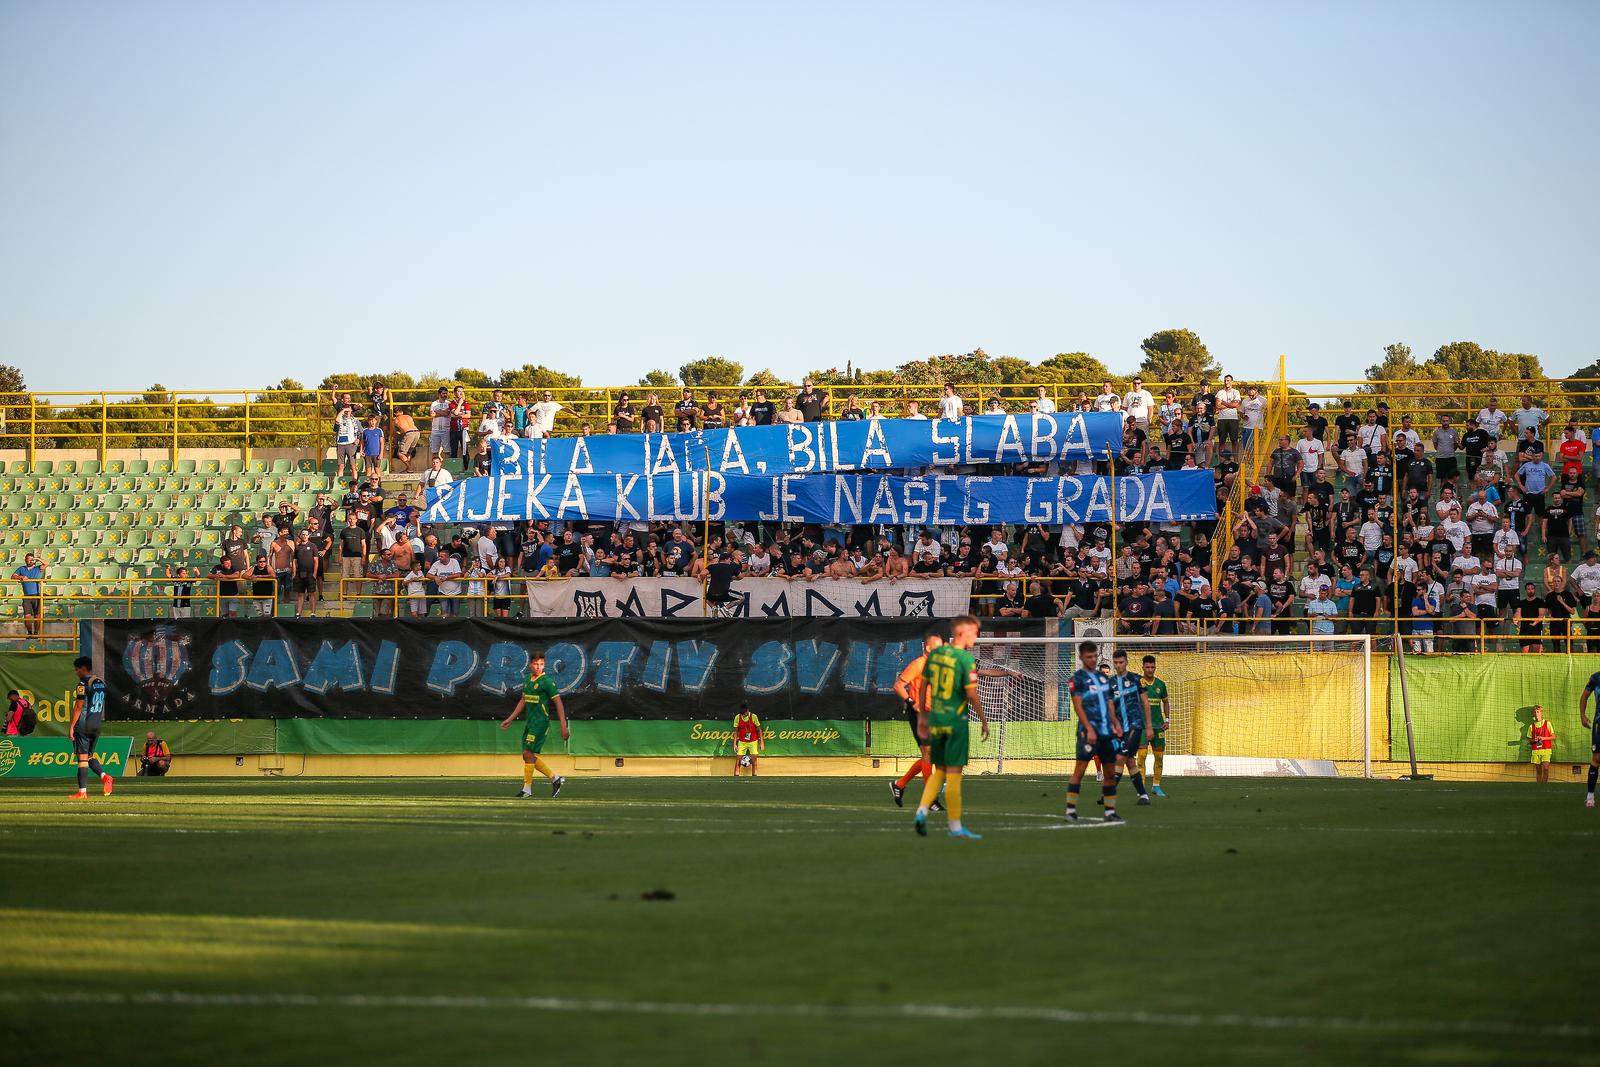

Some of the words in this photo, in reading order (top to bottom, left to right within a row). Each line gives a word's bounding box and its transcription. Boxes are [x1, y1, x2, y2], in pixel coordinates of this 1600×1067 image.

[787, 420, 893, 472] BILA
[429, 473, 589, 522] RIJEKA
[615, 470, 727, 521] KLUB
[758, 474, 806, 523] JE
[207, 639, 401, 696] SAMI
[425, 638, 722, 698] PROTIV
[779, 727, 840, 744] energije
